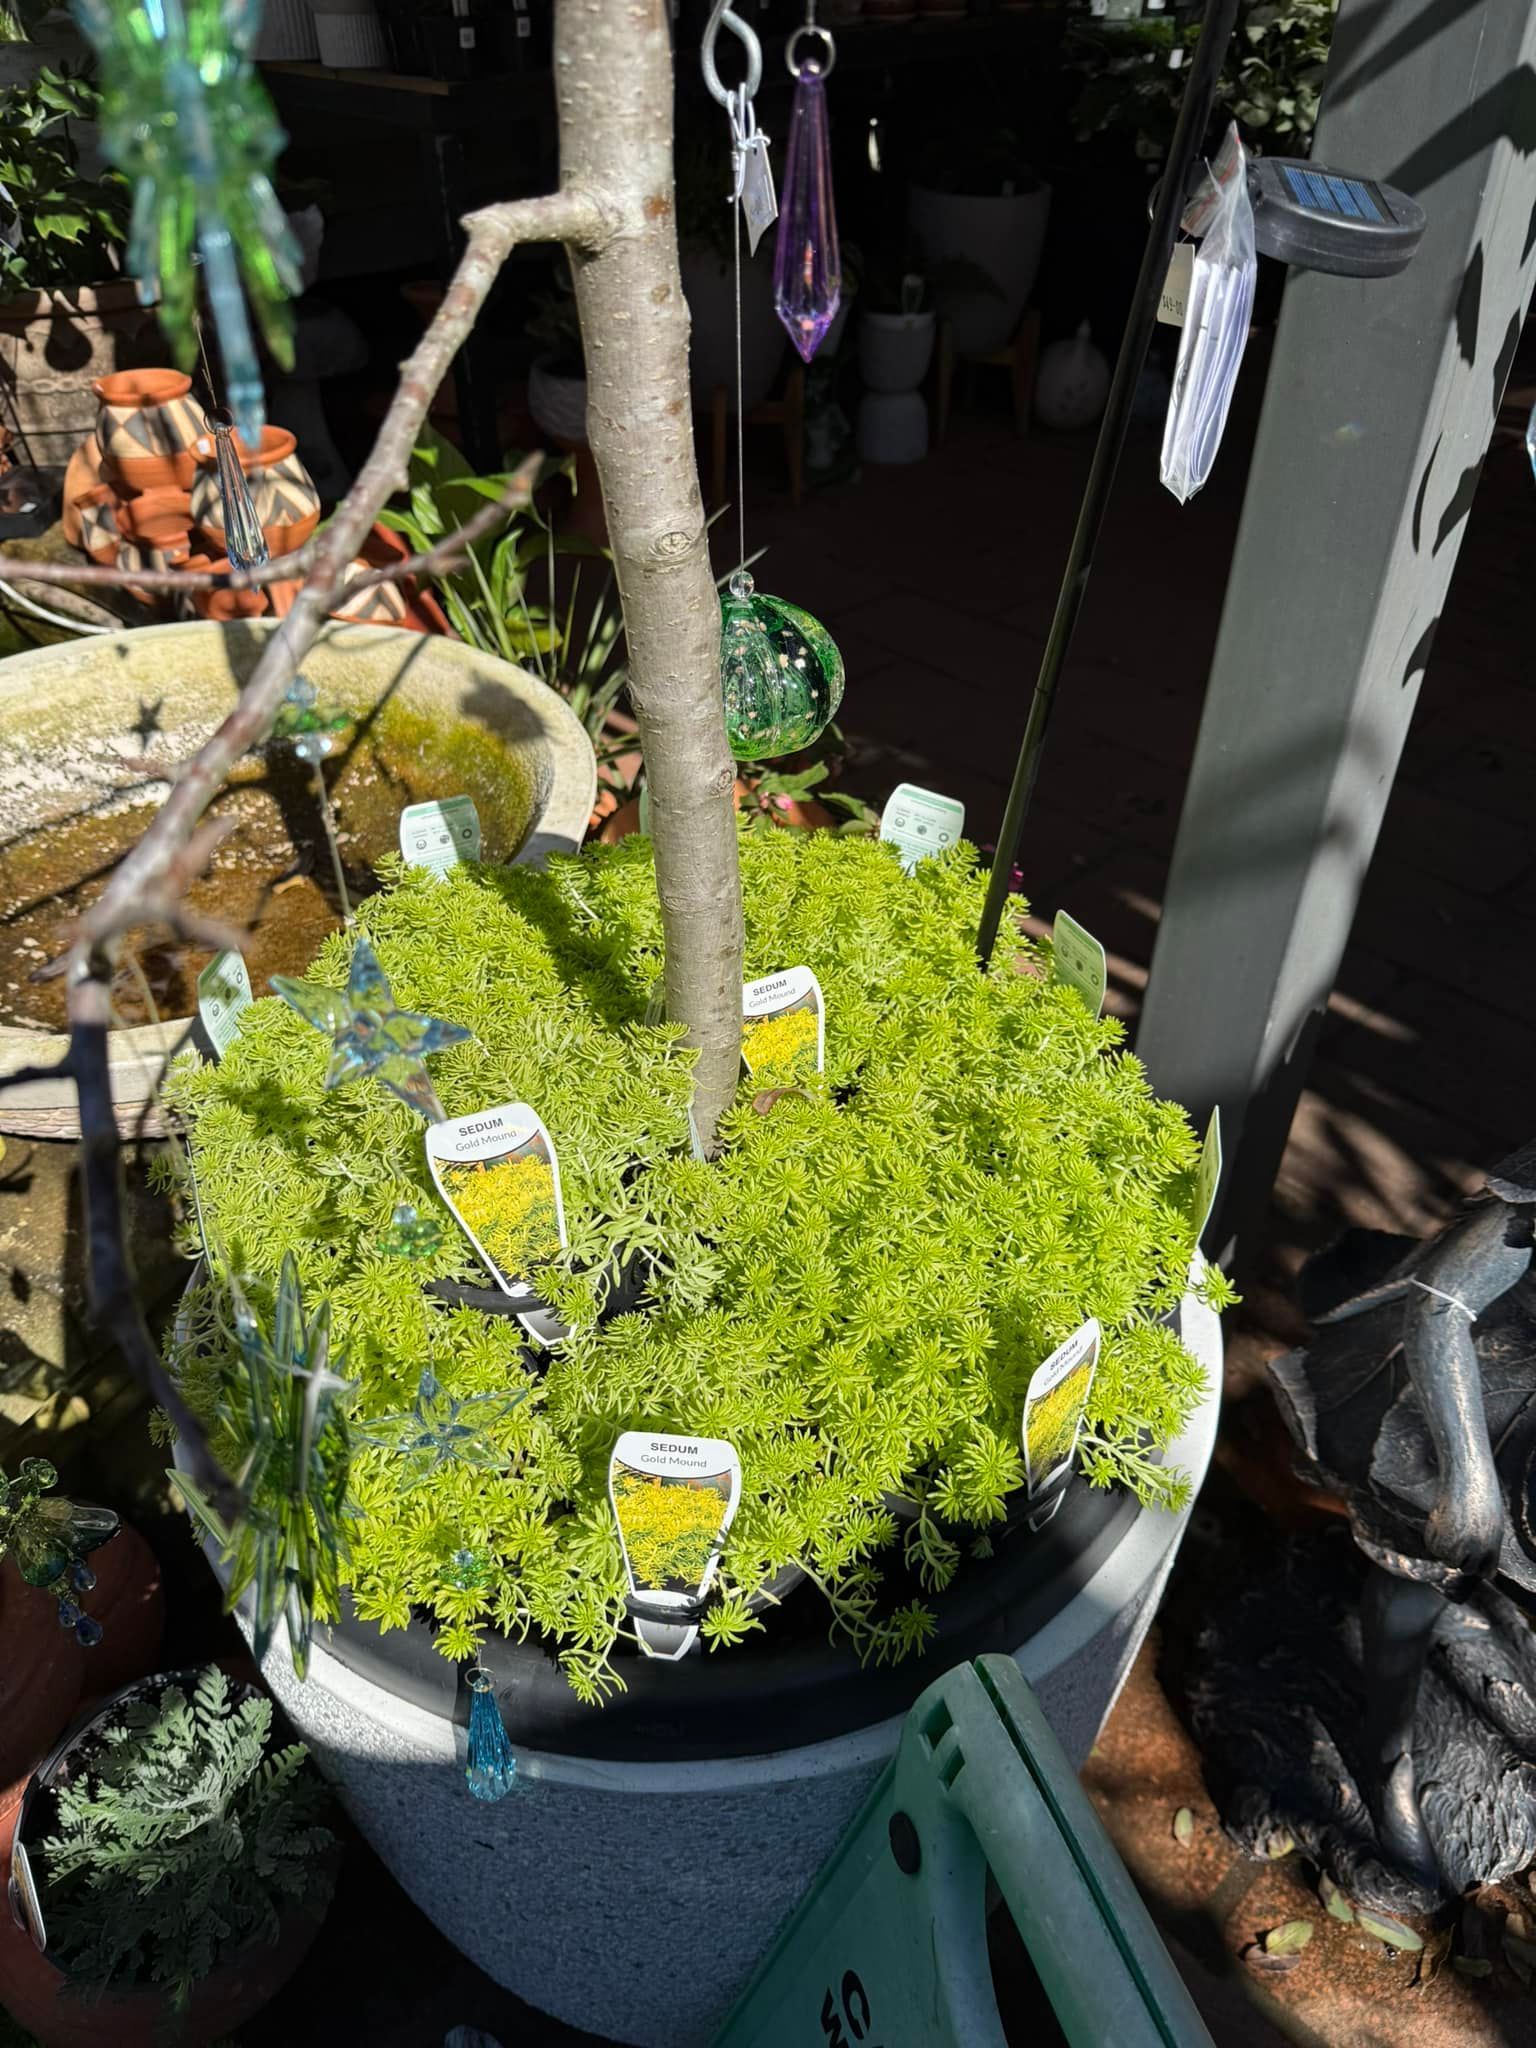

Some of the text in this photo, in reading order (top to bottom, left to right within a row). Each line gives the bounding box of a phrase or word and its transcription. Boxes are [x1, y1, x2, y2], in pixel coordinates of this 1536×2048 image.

[752, 979, 787, 996] SEDUM
[748, 996, 768, 1008] Gold
[458, 1117, 504, 1137] SEDUM
[455, 1137, 480, 1152] Gold
[1050, 1339, 1078, 1371] SEDUM
[650, 1442, 698, 1455] SEDUM
[640, 1454, 708, 1469] Gold Mound
